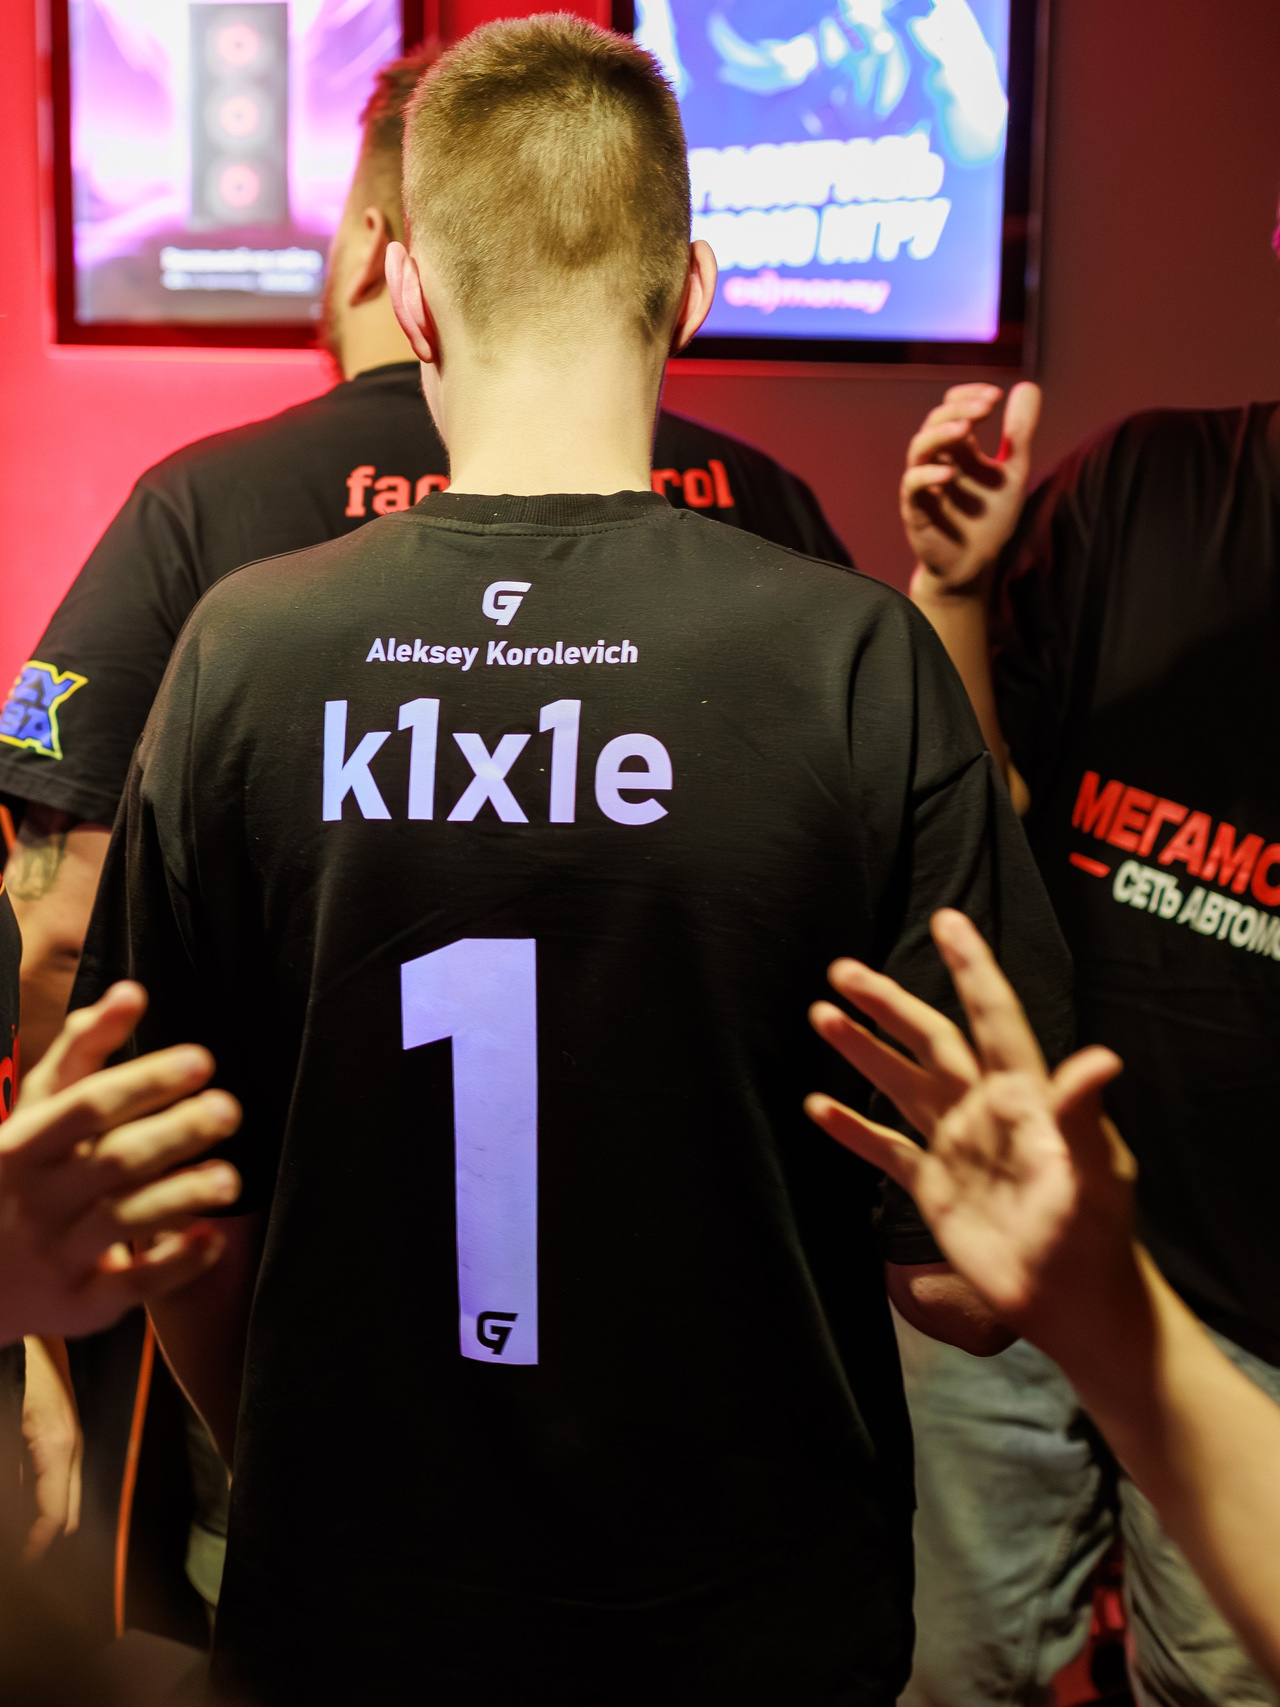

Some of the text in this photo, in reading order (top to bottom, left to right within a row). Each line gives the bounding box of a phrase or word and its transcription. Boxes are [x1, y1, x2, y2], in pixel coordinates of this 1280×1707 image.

[365, 637, 639, 671] Aleksey Korolevich
[322, 697, 674, 826] k1x1e
[1071, 770, 1280, 907] МЕГАМО
[1112, 859, 1280, 962] СЕТЬ АВТОМ
[400, 937, 539, 1366] 1
